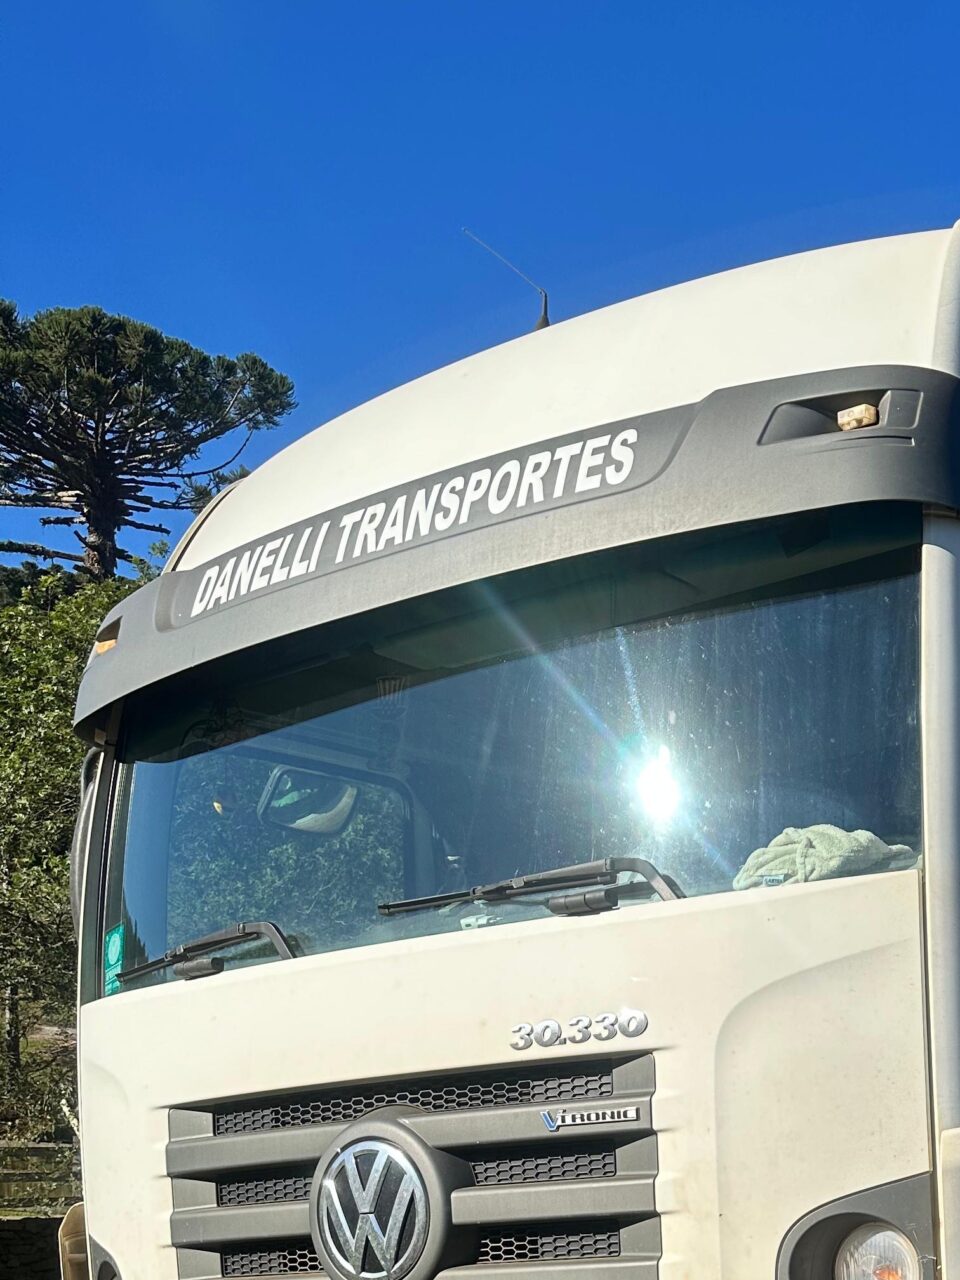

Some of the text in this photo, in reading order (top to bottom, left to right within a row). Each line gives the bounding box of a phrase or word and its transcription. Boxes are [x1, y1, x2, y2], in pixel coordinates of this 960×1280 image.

[190, 428, 639, 618] DANELLI TRANSPORTES
[509, 1008, 649, 1050] 30.330
